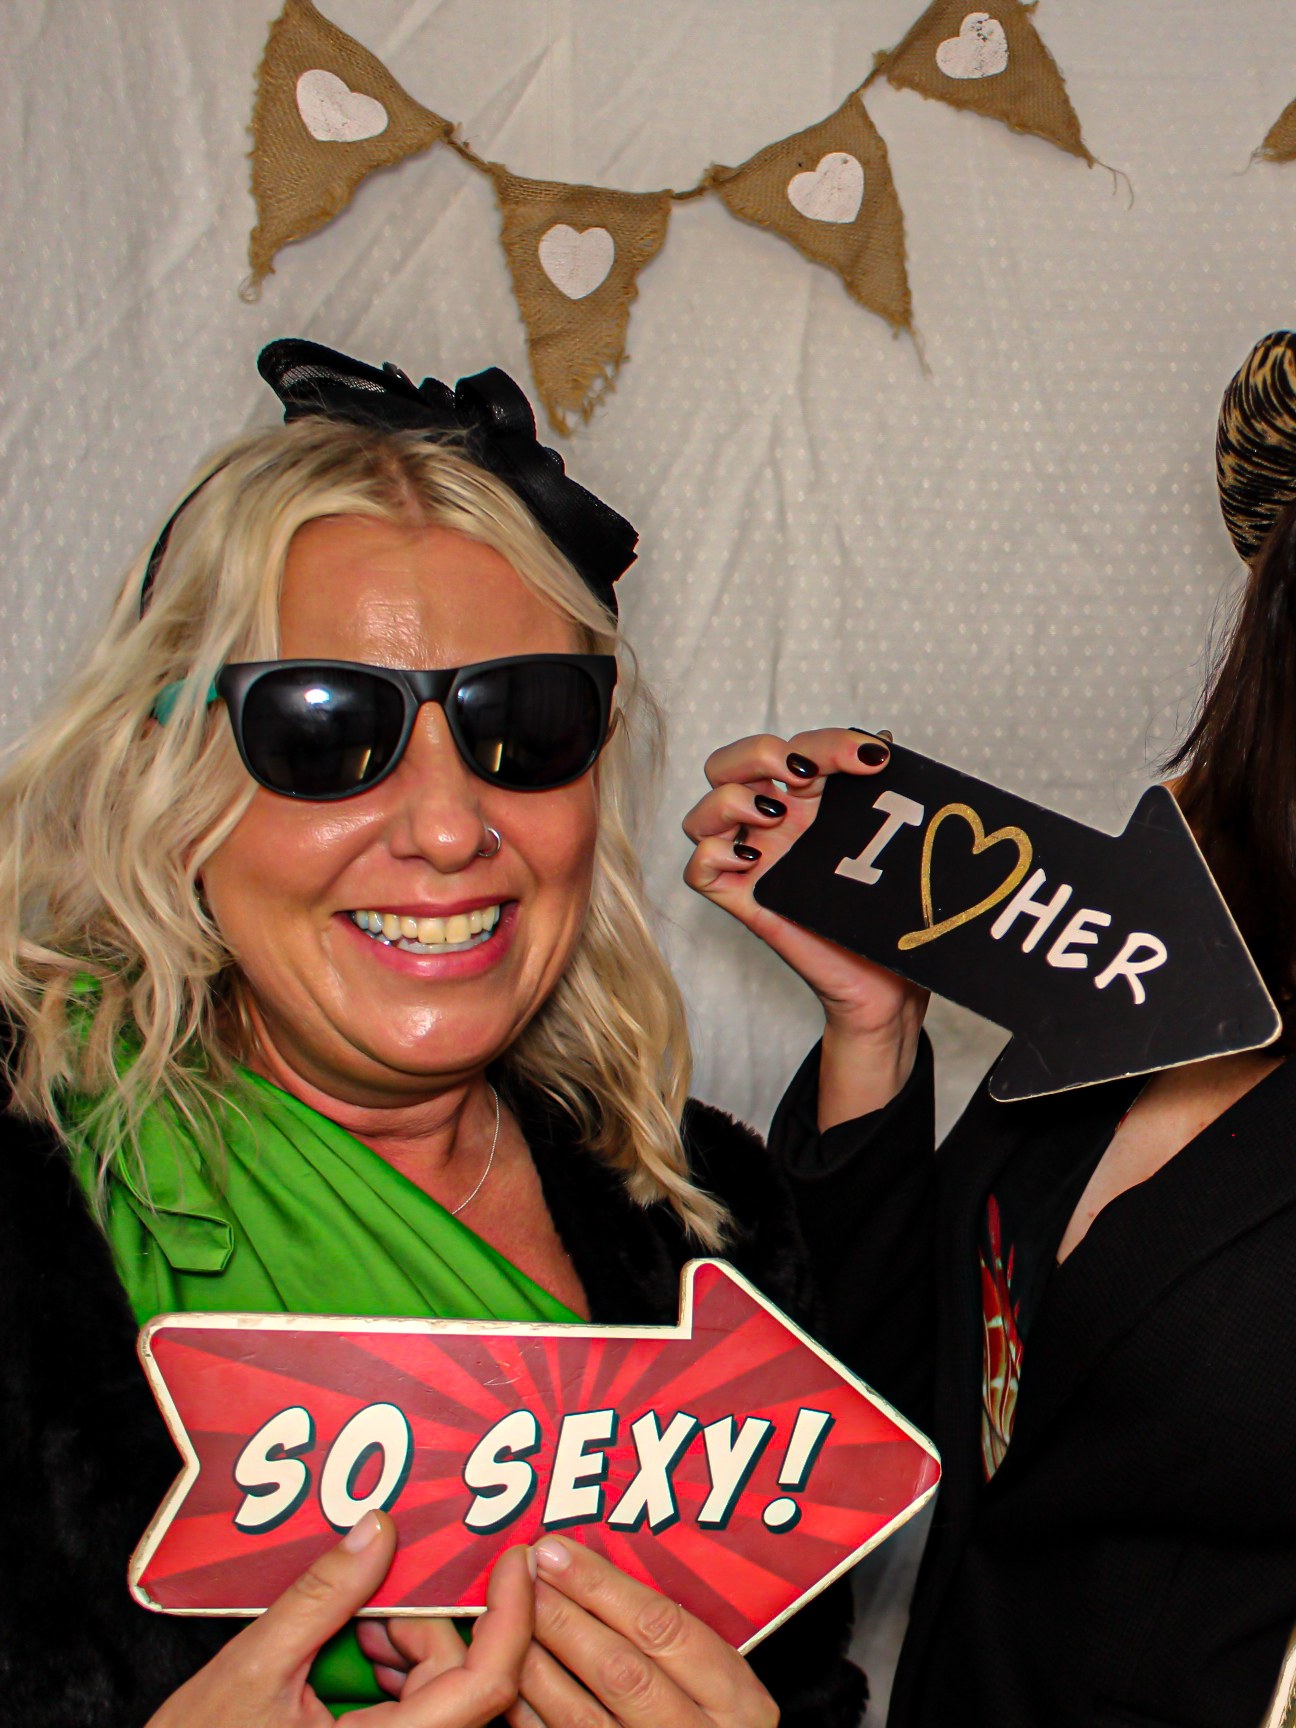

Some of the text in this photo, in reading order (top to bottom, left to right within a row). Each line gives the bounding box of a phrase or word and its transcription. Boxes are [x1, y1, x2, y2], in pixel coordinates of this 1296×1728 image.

[834, 790, 1167, 1005] I HER
[233, 1402, 832, 1534] SO SEXY!
